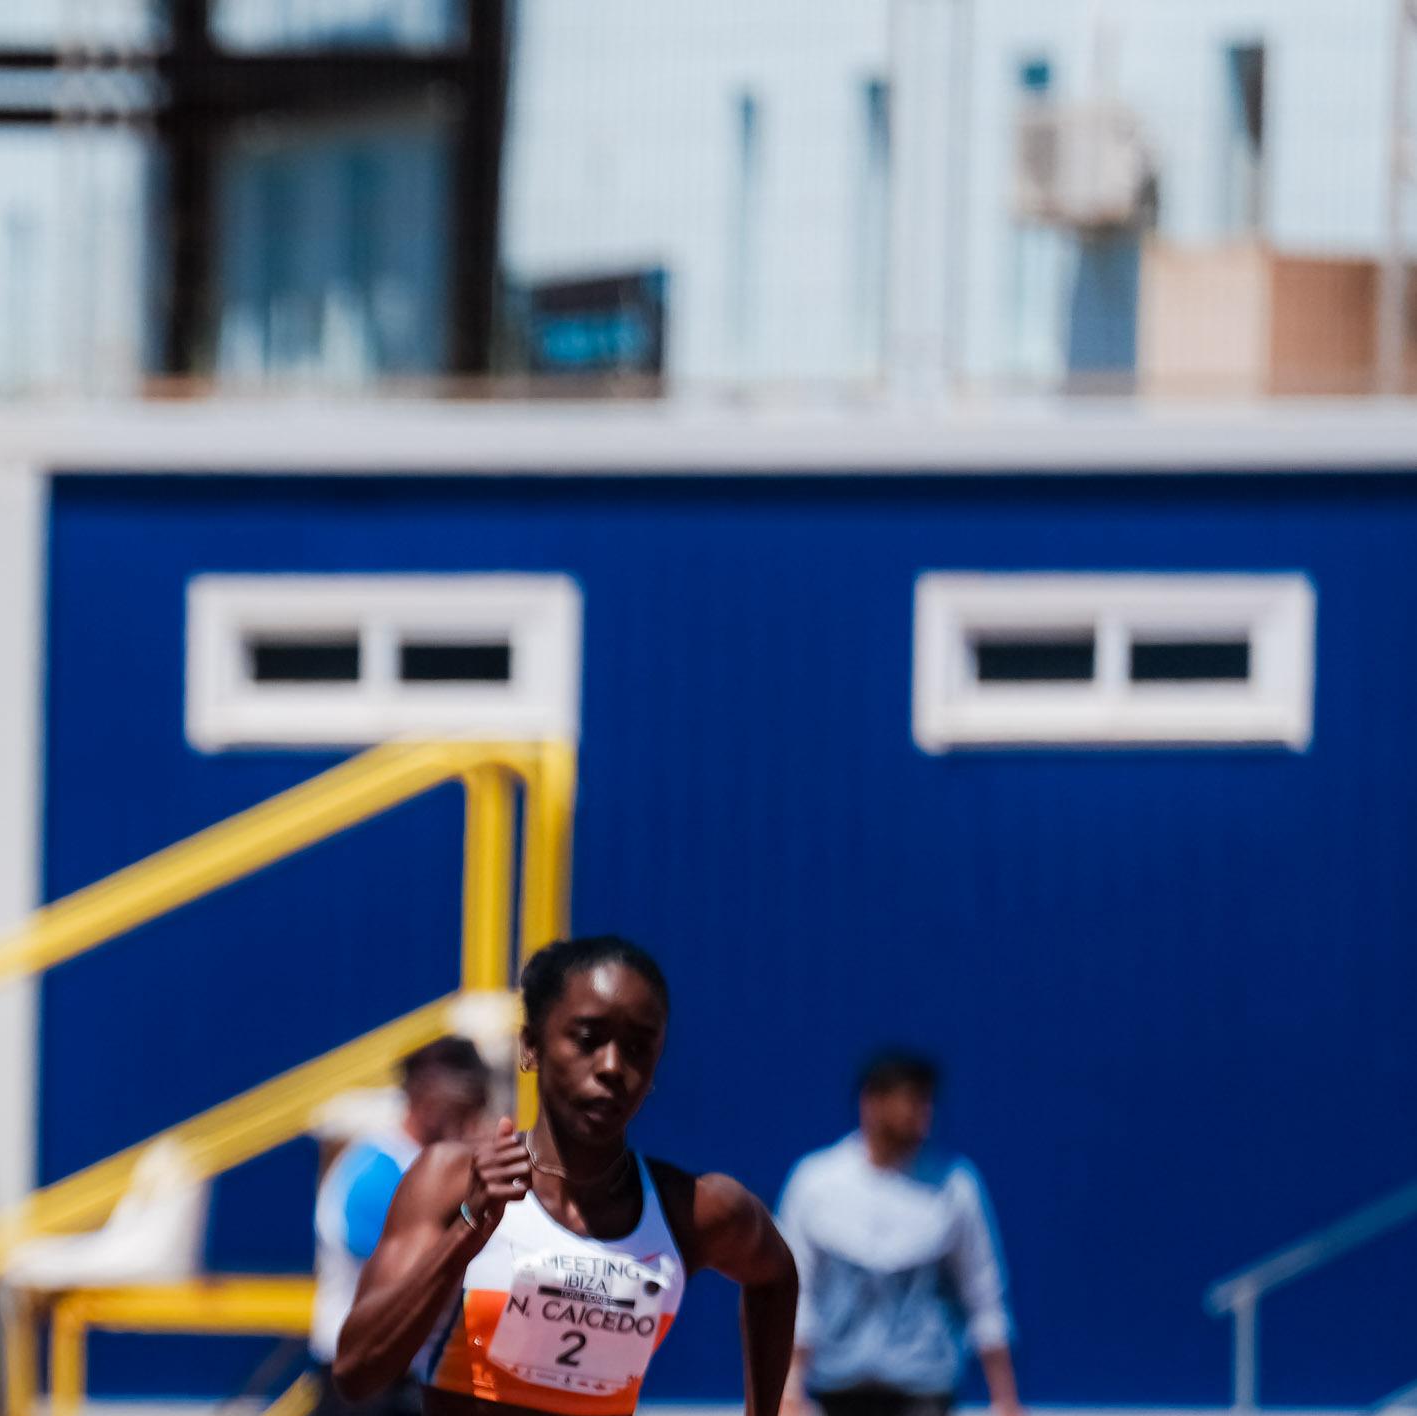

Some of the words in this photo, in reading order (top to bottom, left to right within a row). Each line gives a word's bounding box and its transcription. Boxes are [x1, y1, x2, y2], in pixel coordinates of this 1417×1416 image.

[543, 1254, 641, 1281] MEETING
[563, 1272, 608, 1294] IBIZA
[506, 1295, 530, 1318] N.
[542, 1299, 656, 1337] CAICEDO
[555, 1330, 587, 1367] 2
